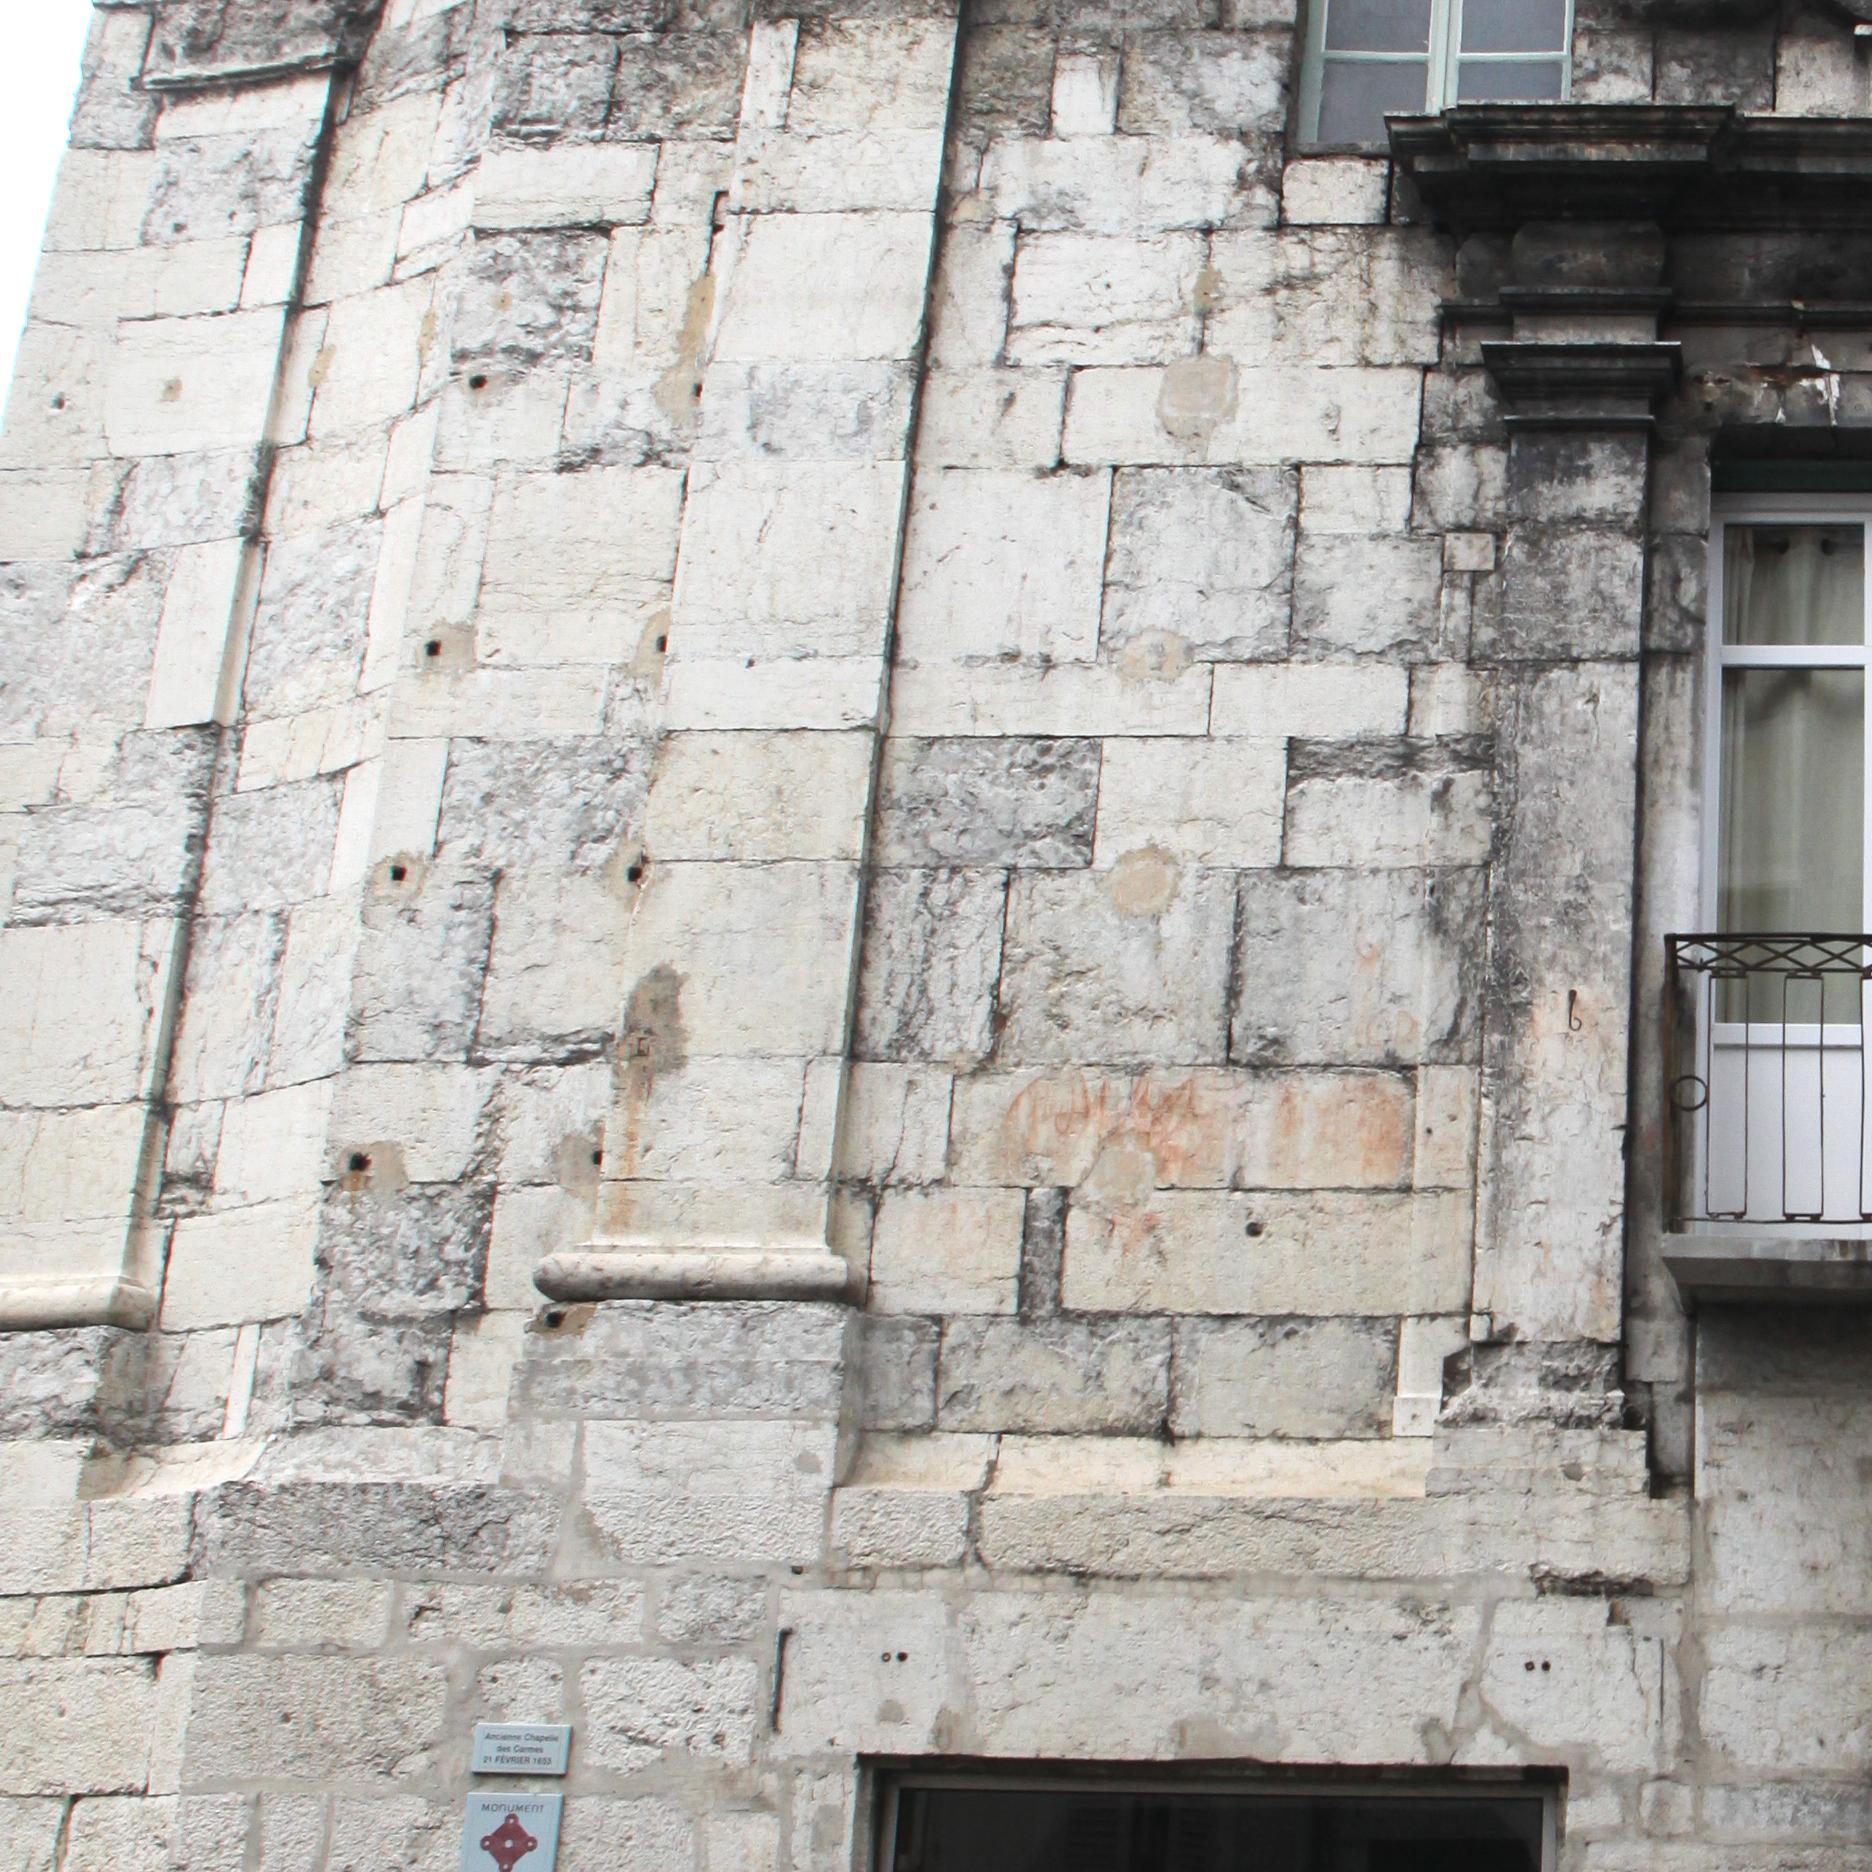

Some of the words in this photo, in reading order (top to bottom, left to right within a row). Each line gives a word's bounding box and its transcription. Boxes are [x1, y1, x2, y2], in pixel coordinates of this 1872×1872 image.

[484, 1732, 521, 1741] Ancienne
[524, 1732, 559, 1743] Chapelle
[483, 1755, 492, 1764] 21
[495, 1754, 530, 1765] FÉVRIER
[481, 1803, 544, 1813] MONUMENT
